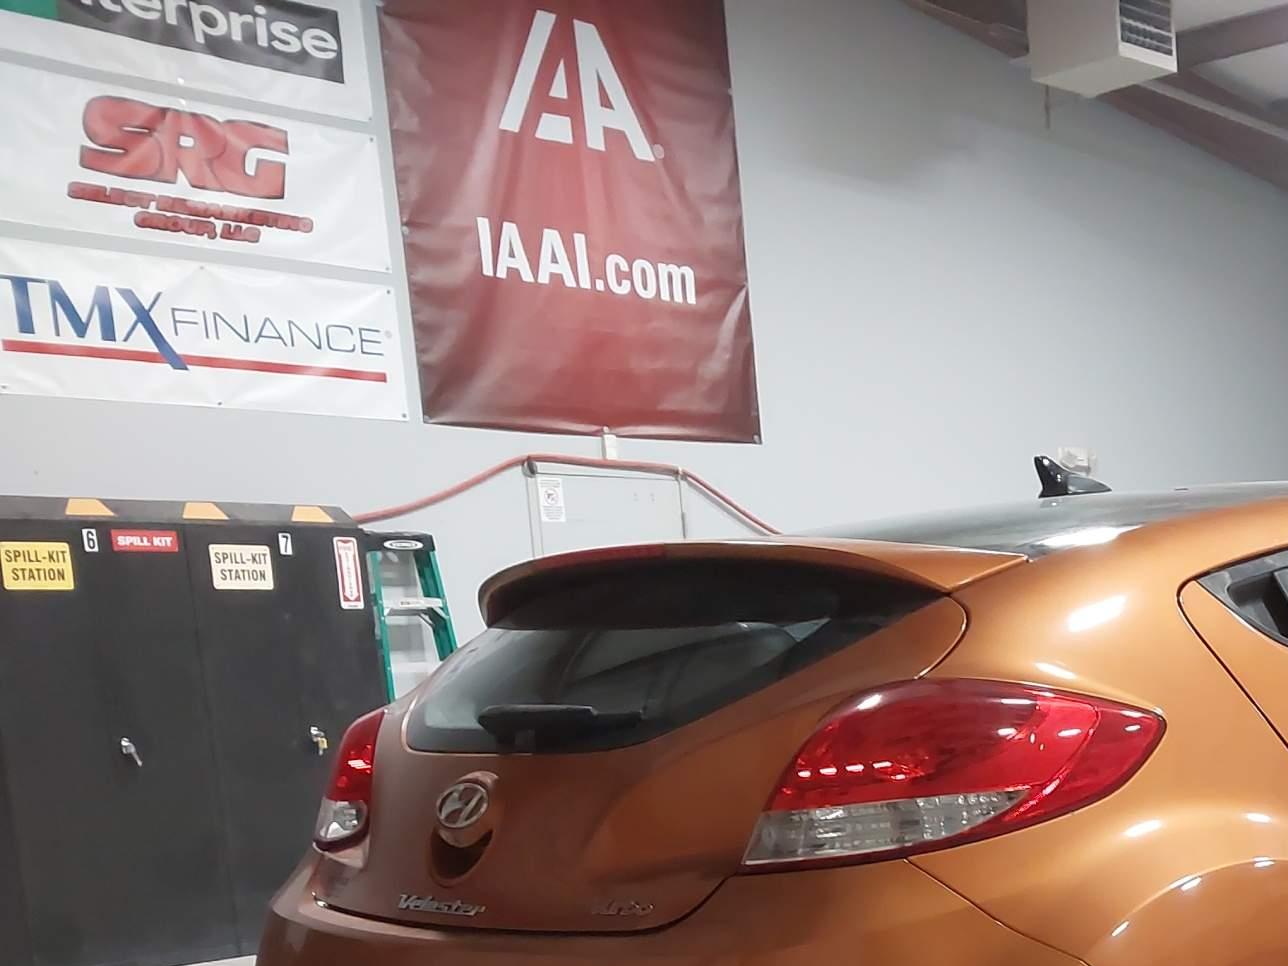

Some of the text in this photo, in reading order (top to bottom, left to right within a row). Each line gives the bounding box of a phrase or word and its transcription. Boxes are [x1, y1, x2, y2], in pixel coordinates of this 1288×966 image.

[80, 0, 338, 60] erprise
[499, 9, 656, 162] IAA
[79, 95, 290, 200] SRG
[476, 216, 697, 305] IAAI.com
[0, 274, 385, 371] TMX FINANCE
[86, 530, 96, 550] 6
[117, 536, 173, 547] SPILL KIT
[281, 535, 290, 553] 7
[4, 549, 68, 564] SPILL-KIT
[214, 551, 269, 565] SPILL-KIT
[11, 567, 66, 582] STATION
[220, 568, 267, 582] STATION
